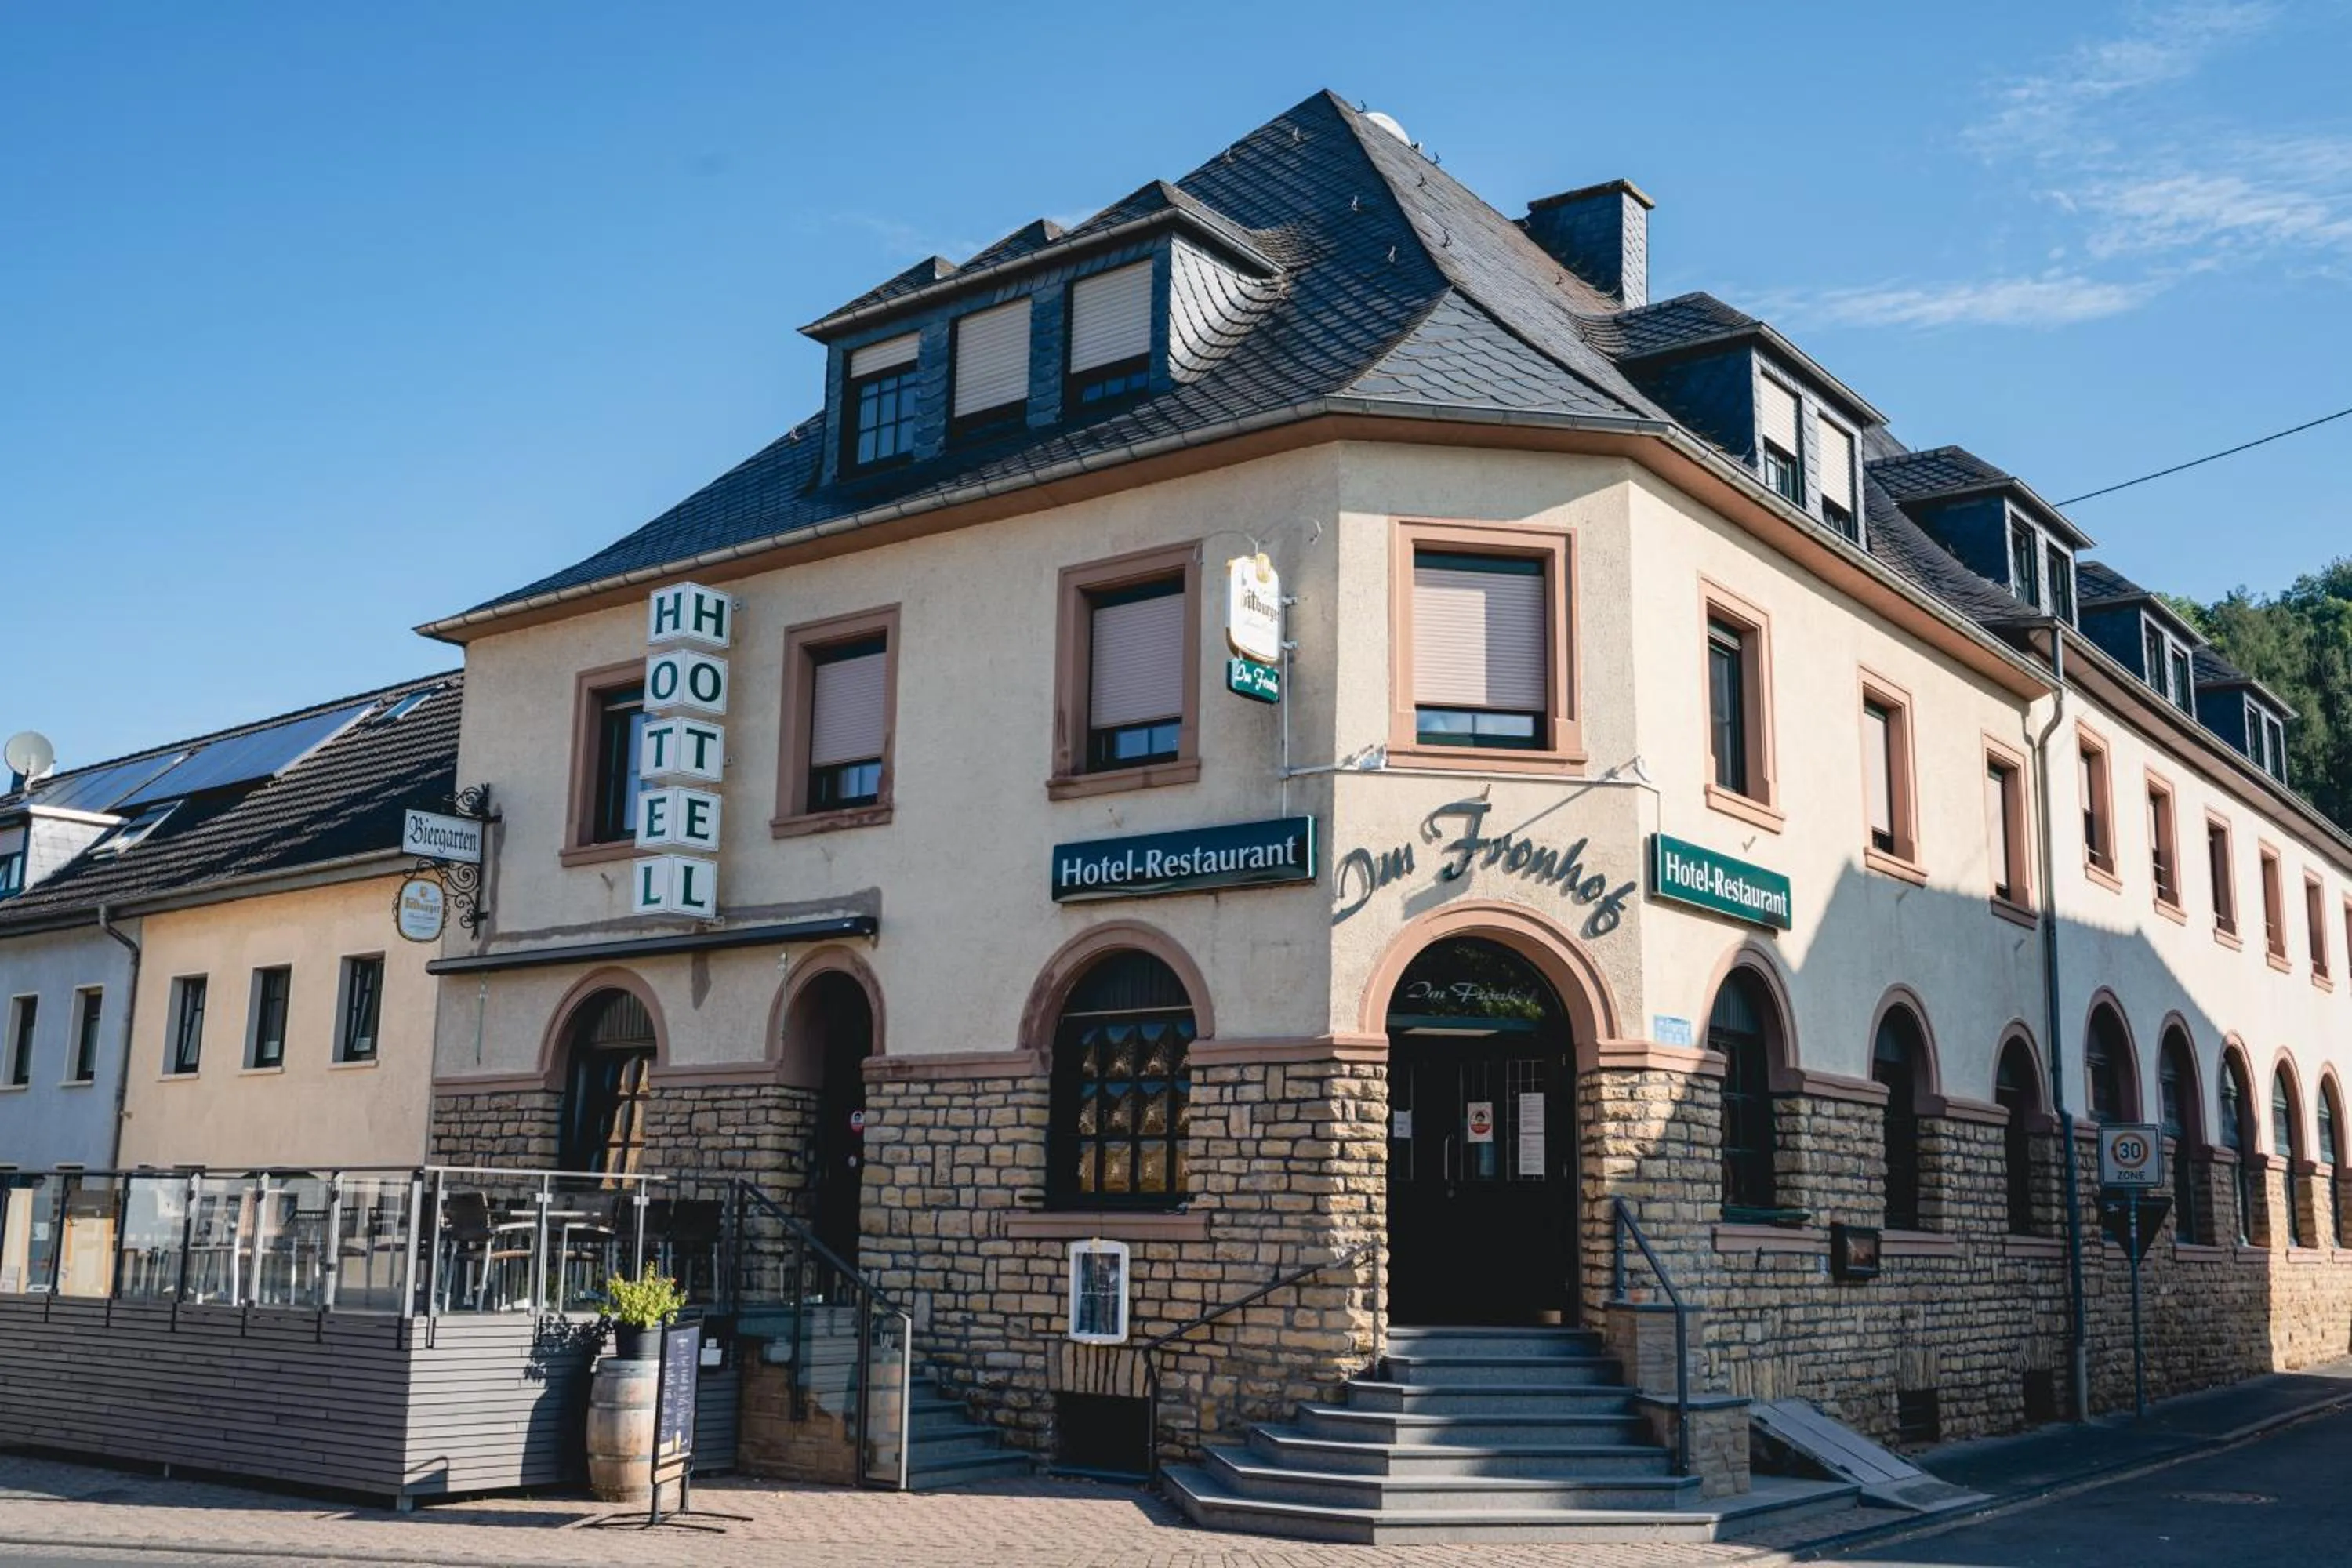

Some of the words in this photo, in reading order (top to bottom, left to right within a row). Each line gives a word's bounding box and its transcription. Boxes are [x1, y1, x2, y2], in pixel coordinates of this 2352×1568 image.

[642, 592, 682, 906] HOTEL
[681, 593, 725, 907] HOTEL
[408, 815, 477, 853] Biergarten
[1061, 834, 1298, 887] Hotel-Restaurant
[1427, 784, 1637, 938] Fronhof
[1665, 851, 1788, 916] Hotel-Restaurant
[2117, 1170, 2146, 1180] ZONE
[2119, 1142, 2141, 1159] 30
